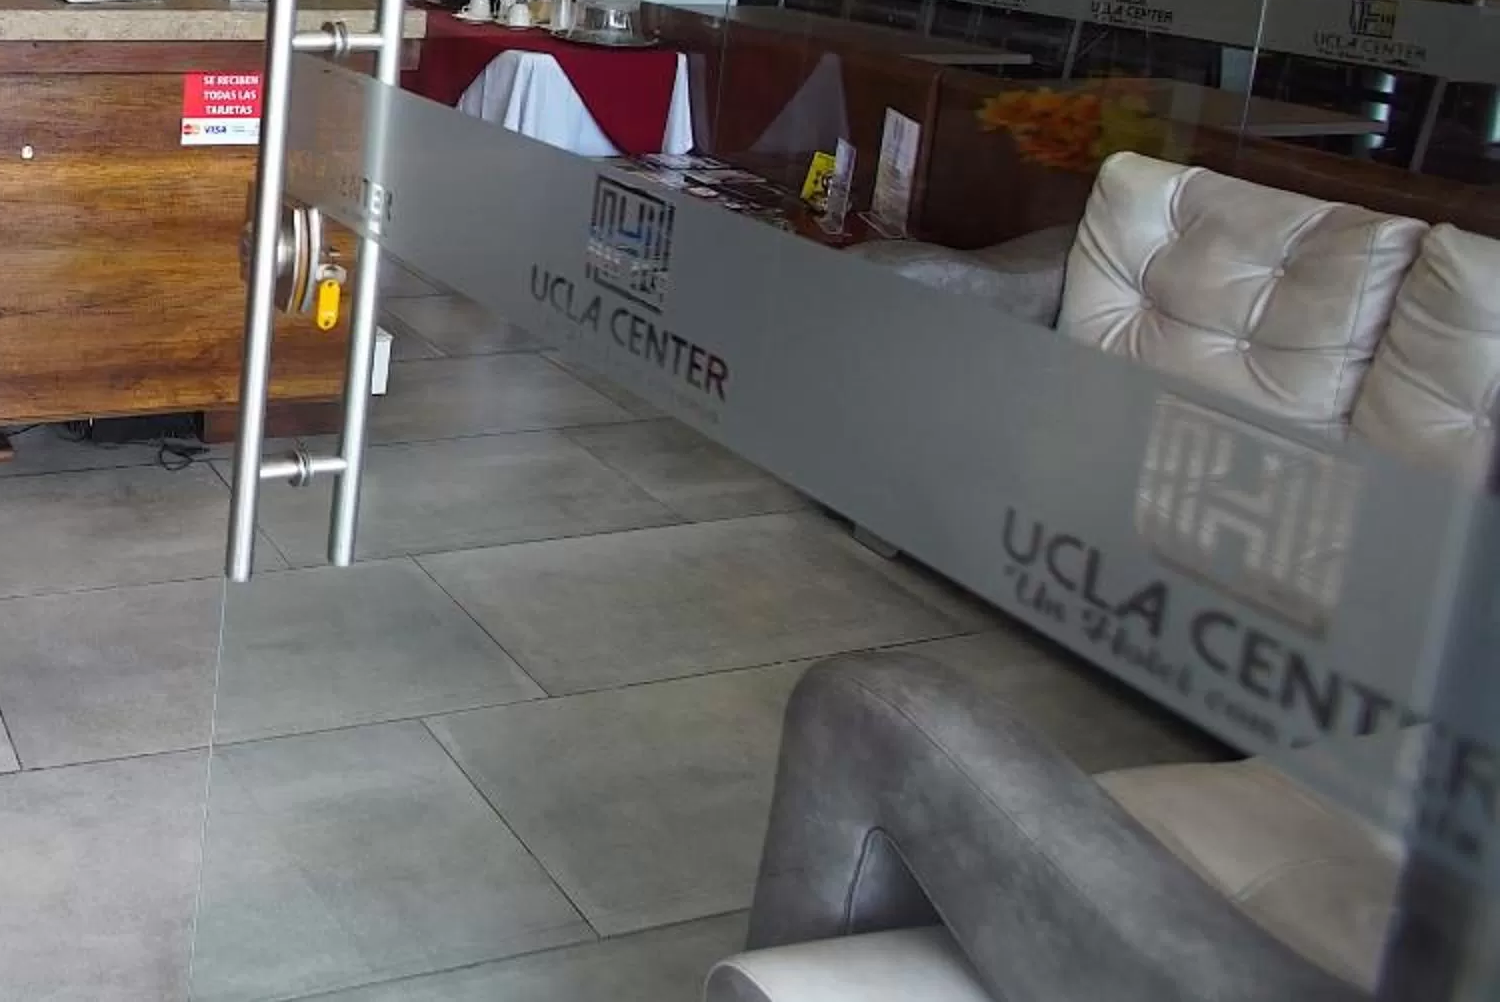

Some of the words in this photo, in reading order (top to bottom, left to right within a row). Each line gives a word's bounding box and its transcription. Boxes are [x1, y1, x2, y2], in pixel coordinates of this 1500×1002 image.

[203, 75, 215, 85] SE
[217, 75, 259, 86] RECIBEN
[203, 89, 237, 100] TODAS
[238, 90, 257, 100] LAS
[205, 105, 253, 115] TARJETAS
[203, 125, 227, 134] VISA
[530, 262, 602, 332] UCLA
[610, 307, 729, 402] CENTER
[1002, 505, 1171, 640] UCLA
